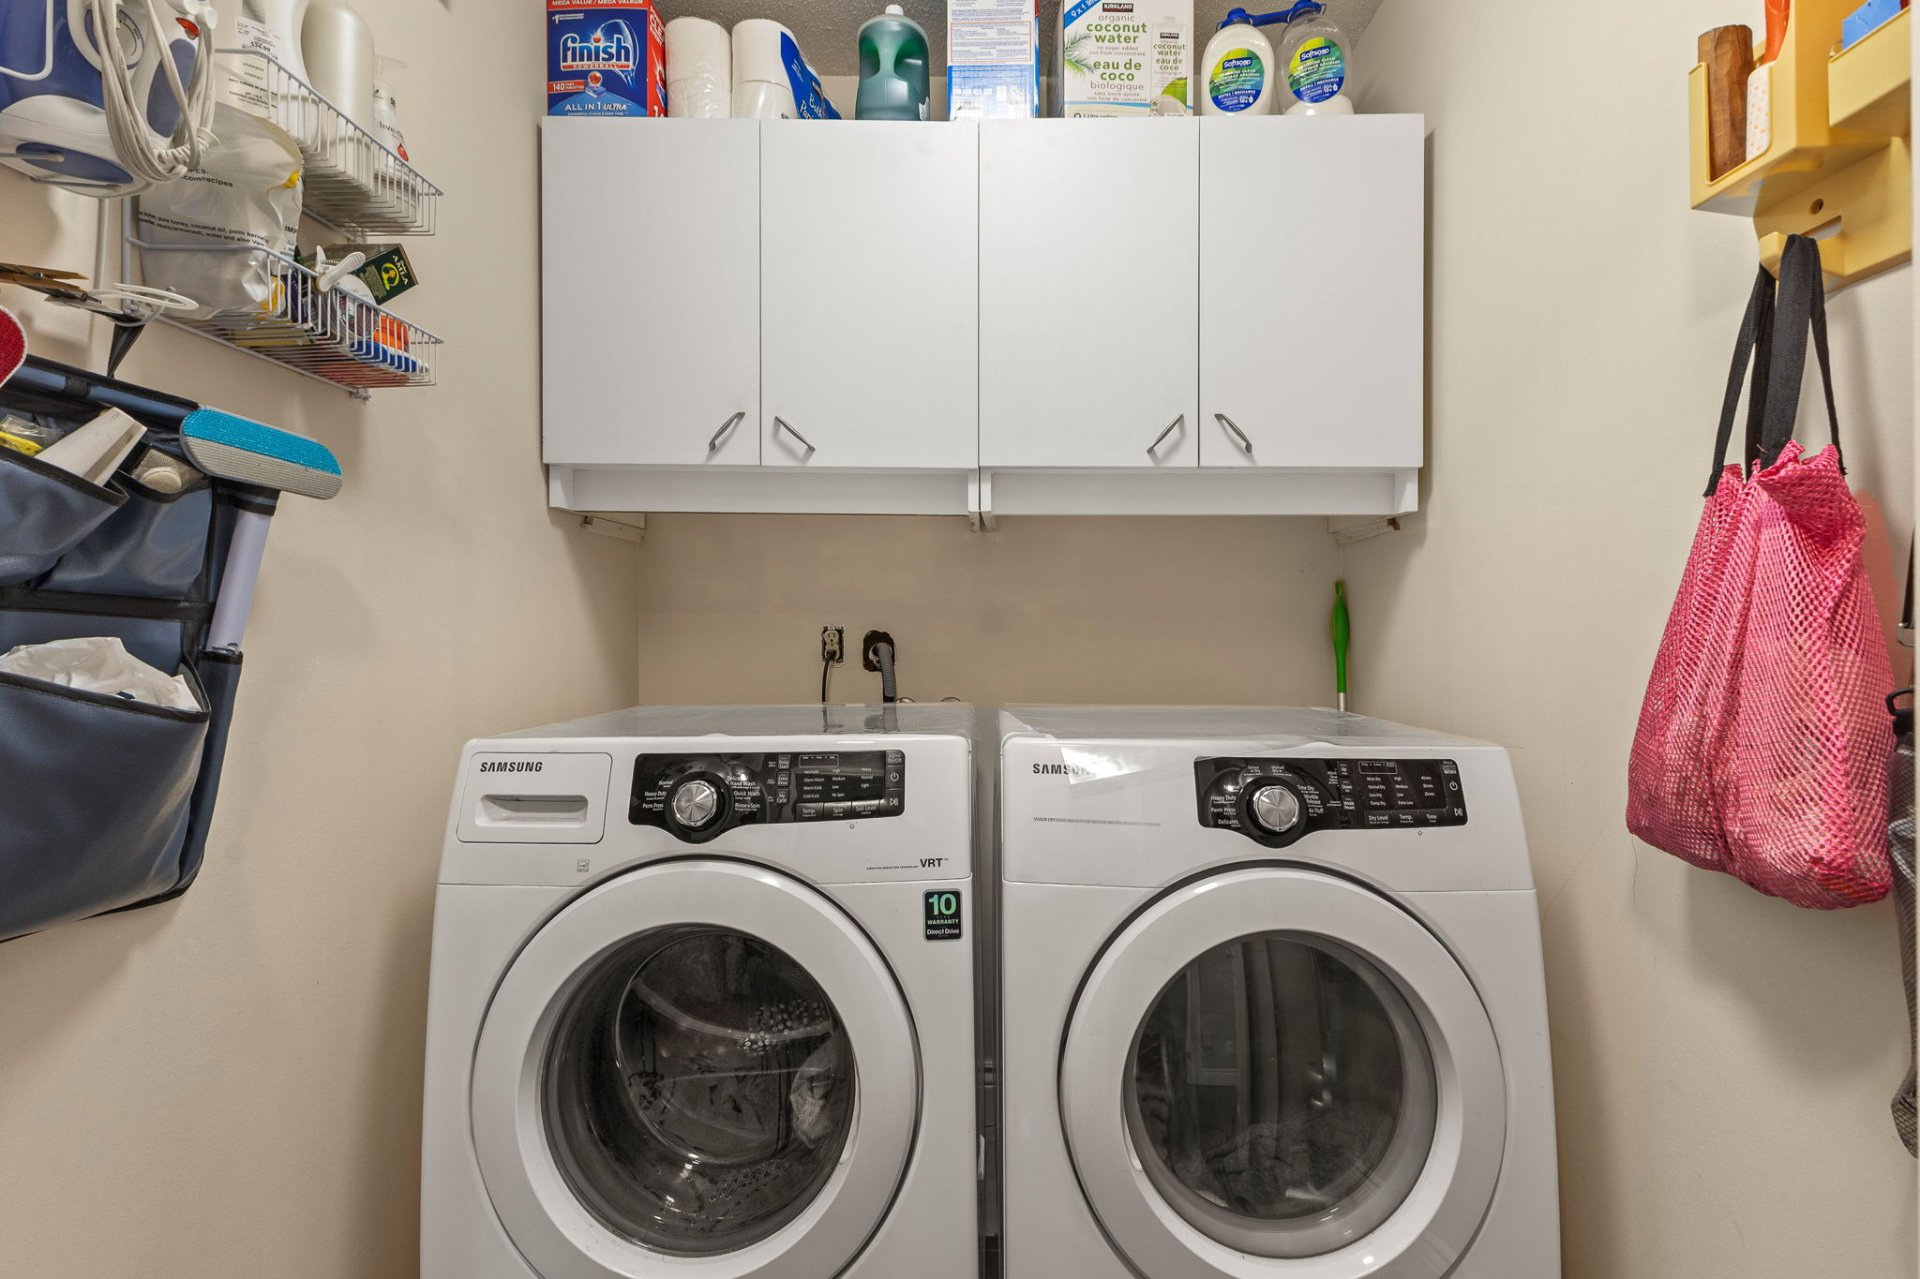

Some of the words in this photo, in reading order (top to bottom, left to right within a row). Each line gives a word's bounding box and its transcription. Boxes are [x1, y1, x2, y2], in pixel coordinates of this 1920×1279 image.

[1098, 14, 1135, 23] organic
[1086, 22, 1147, 33] coconut
[1094, 33, 1139, 44] water
[561, 33, 632, 63] finish
[1093, 61, 1120, 70] eau
[1123, 58, 1142, 70] de
[1100, 72, 1135, 81] coco
[1090, 81, 1144, 92] biologique
[191, 223, 216, 232] coconut
[392, 256, 408, 284] AMLA
[480, 762, 543, 772] SAMSUNG
[920, 858, 943, 868] VRT
[928, 894, 957, 916] 10
